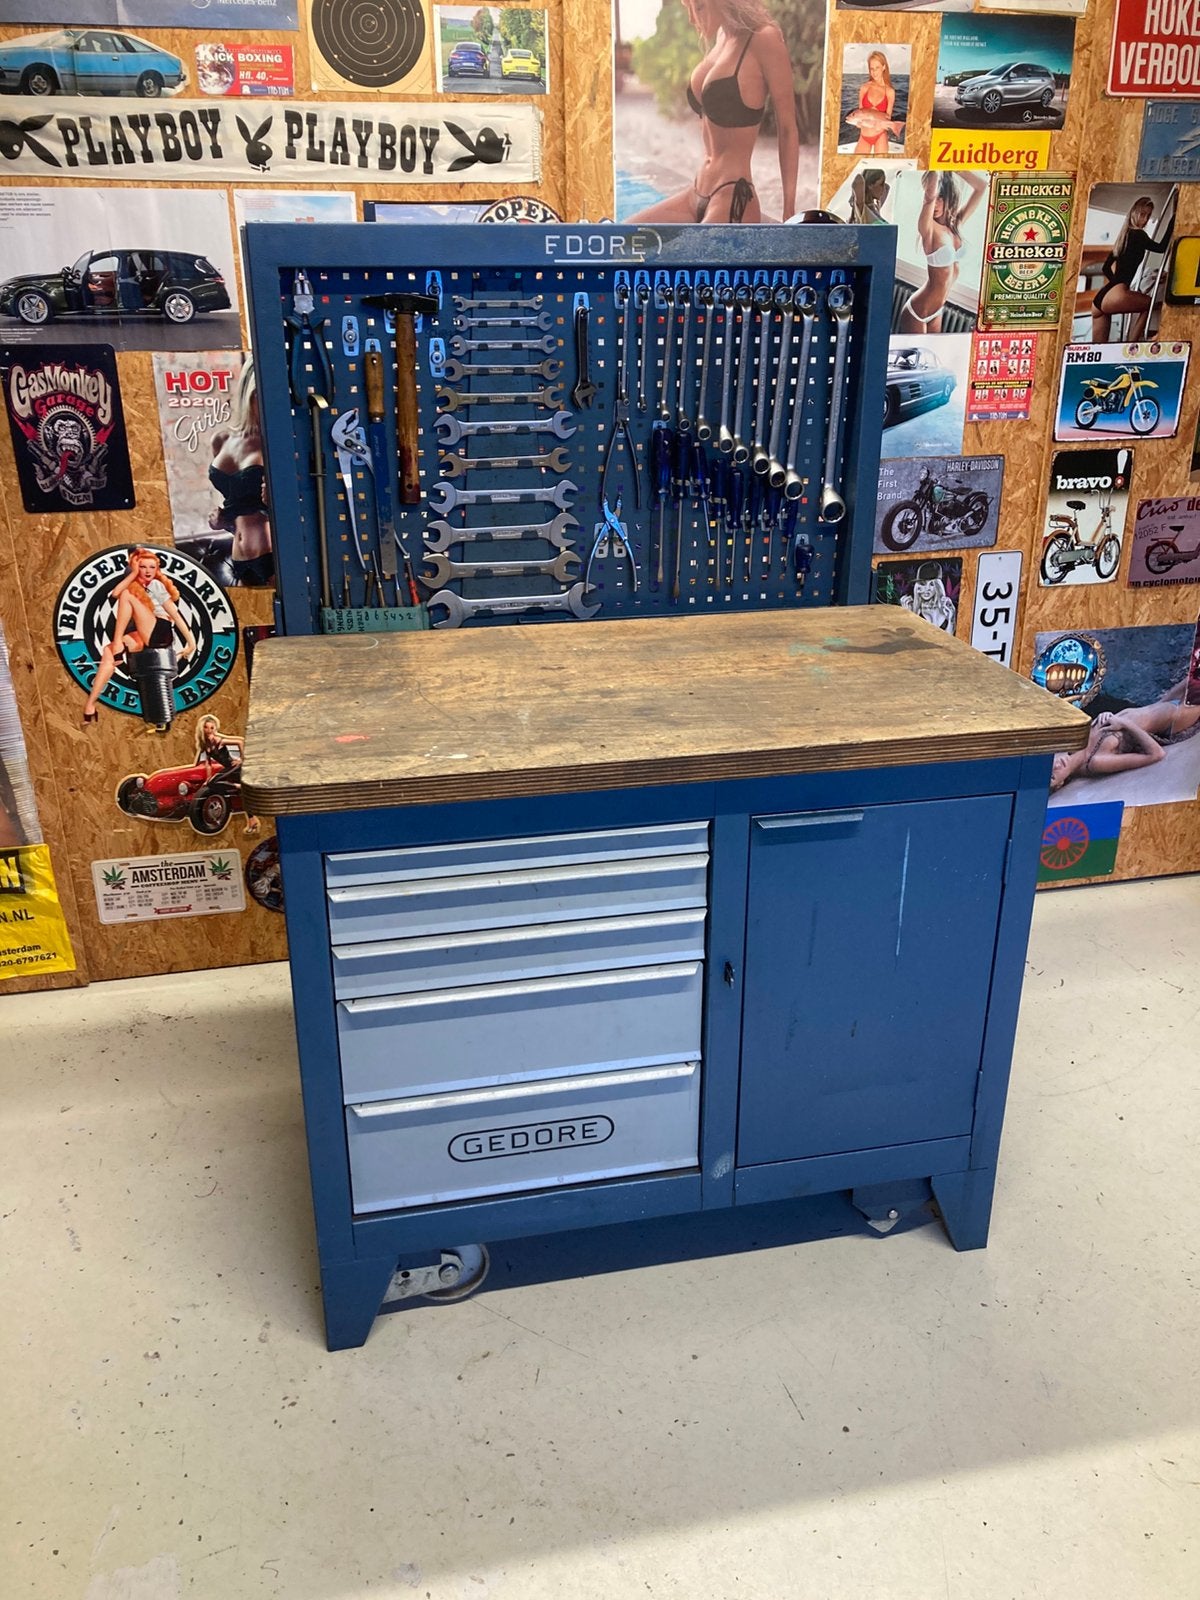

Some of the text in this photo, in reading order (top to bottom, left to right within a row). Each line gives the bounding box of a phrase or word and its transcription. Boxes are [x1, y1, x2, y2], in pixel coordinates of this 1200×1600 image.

[197, 45, 235, 62] KICK
[238, 53, 283, 63] BOXING
[57, 108, 223, 167] PLAYBOY
[284, 110, 440, 174] PLAYBOY
[937, 142, 1038, 169] Zuidberg
[1023, 292, 1047, 300] QUALITY
[164, 370, 232, 393] HOT
[34, 394, 94, 416] Garage
[168, 397, 214, 407] 2020
[174, 398, 230, 453] Girls
[878, 467, 895, 476] The
[877, 480, 898, 488] First
[1056, 475, 1112, 490] bravo
[877, 491, 902, 500] Brand
[1136, 500, 1184, 521] Ciao
[59, 552, 227, 630] BIGGER SPARK
[179, 644, 232, 705] BANG
[132, 865, 206, 884] AMSTERDAM
[464, 1121, 598, 1155] GEDORE
